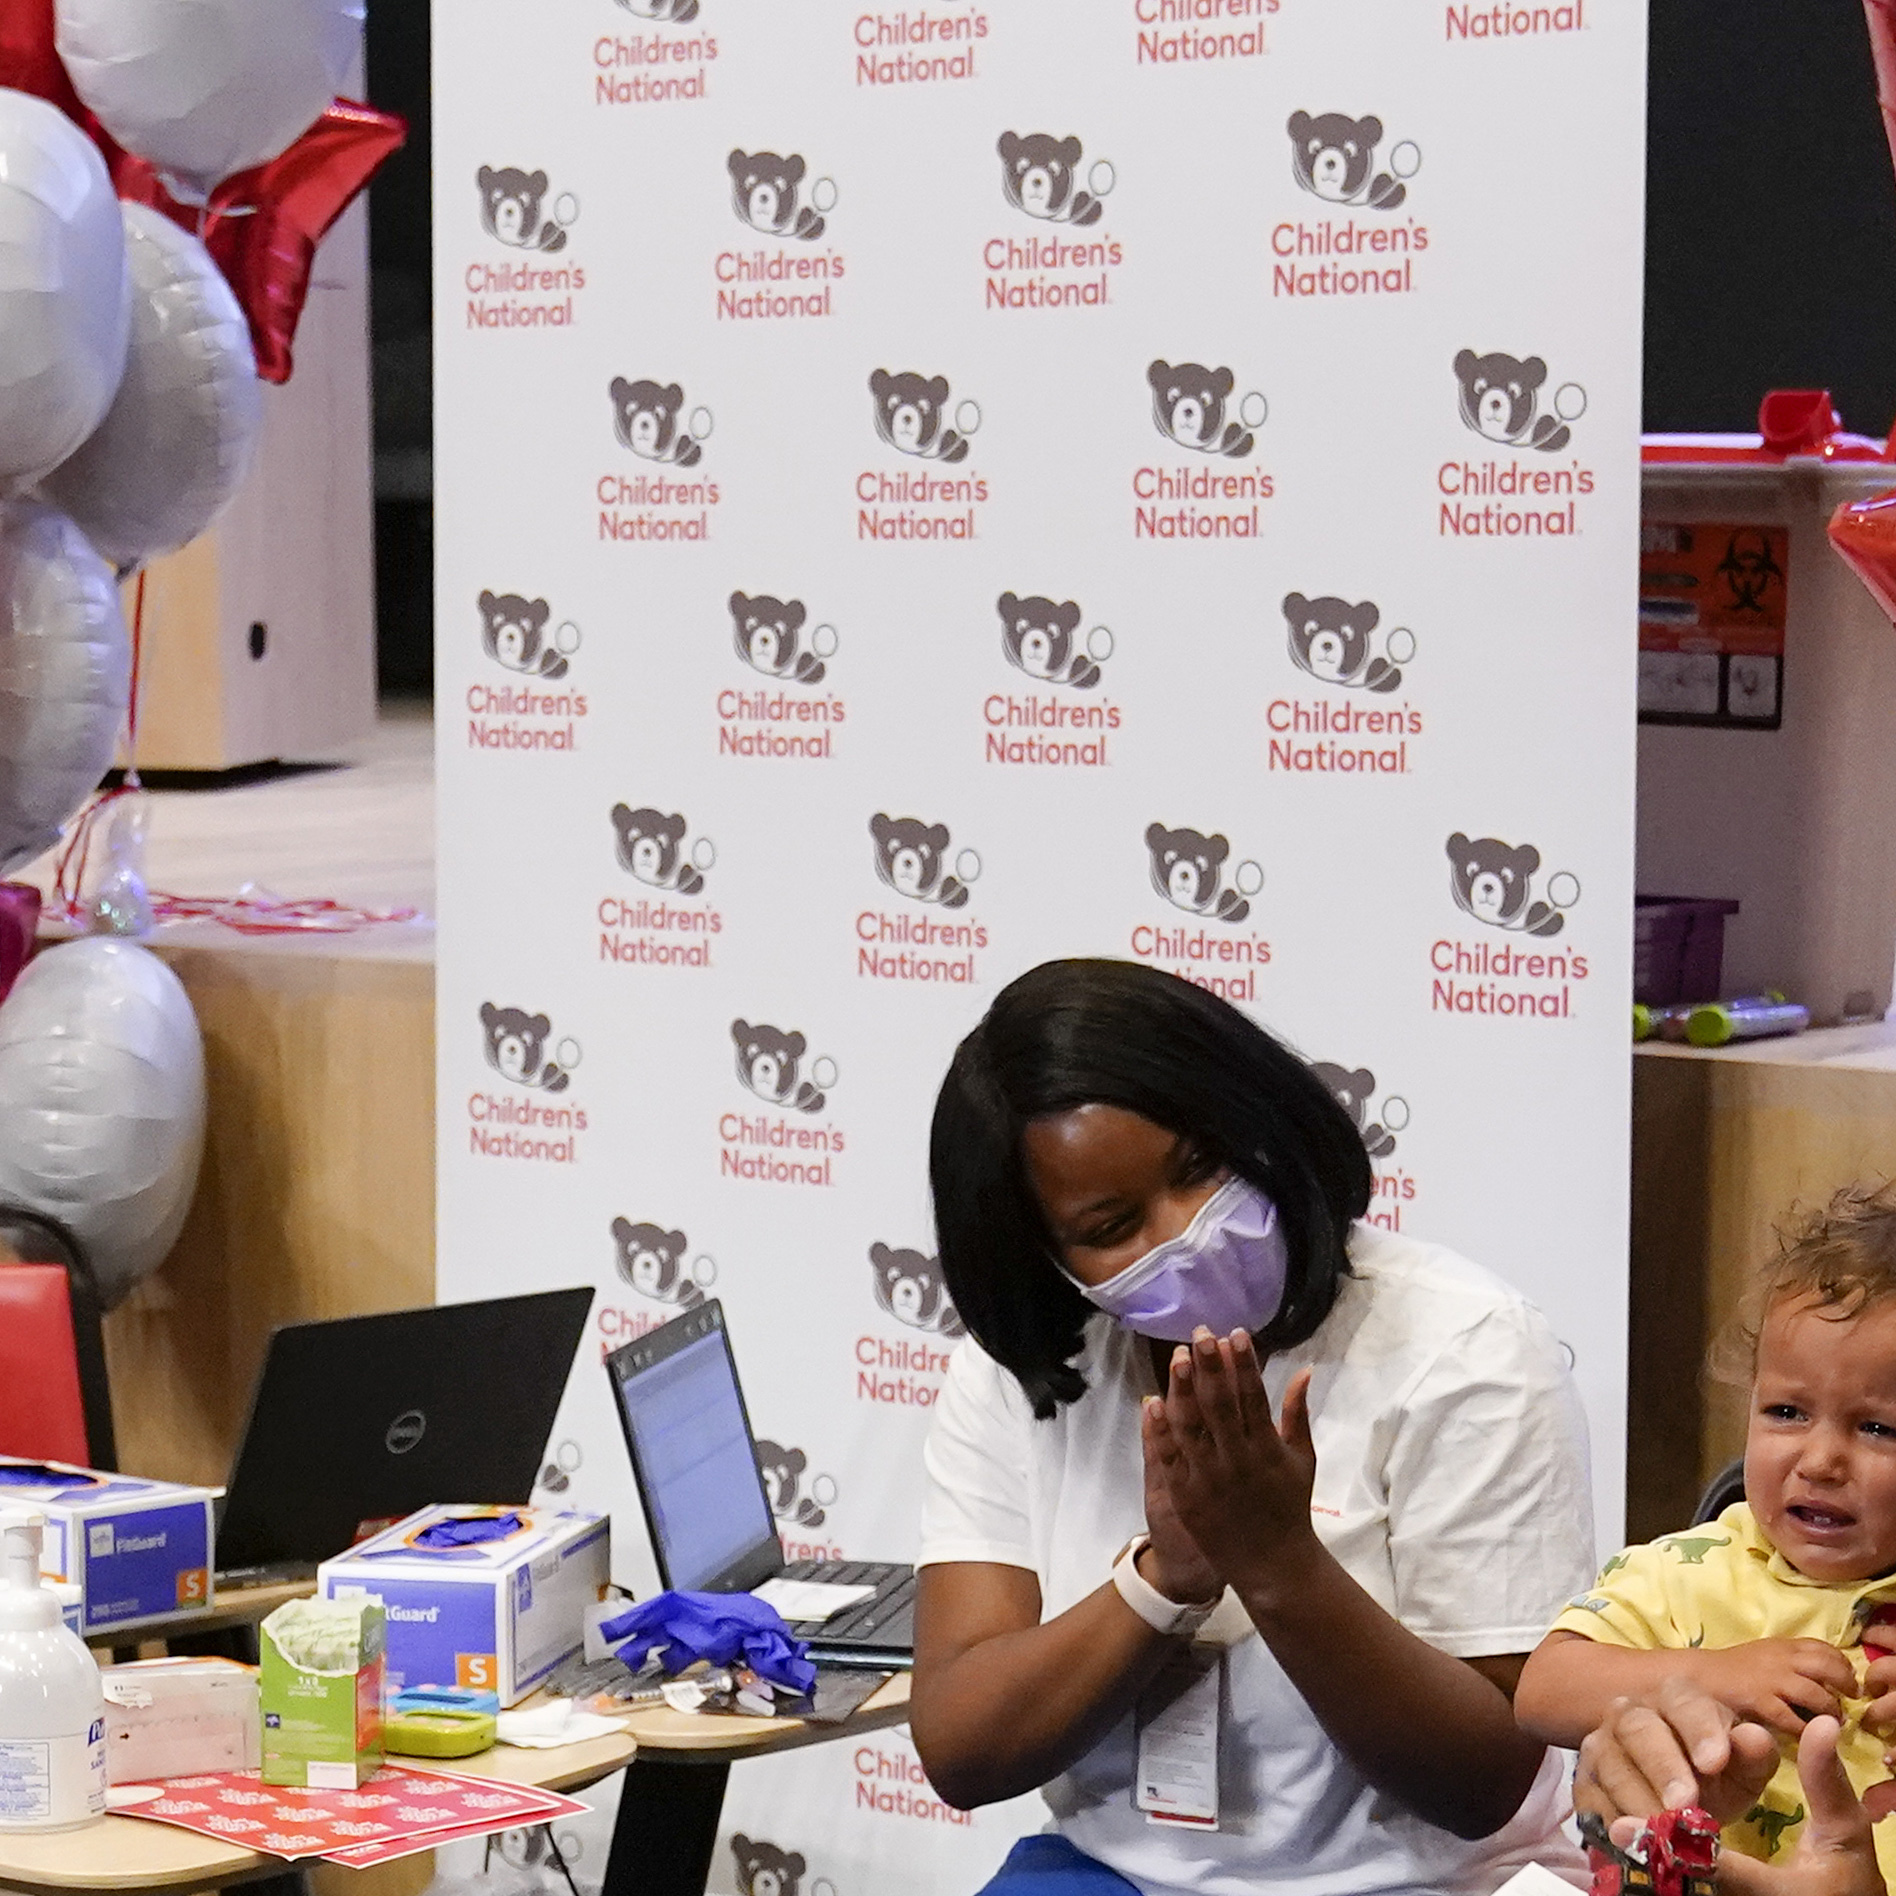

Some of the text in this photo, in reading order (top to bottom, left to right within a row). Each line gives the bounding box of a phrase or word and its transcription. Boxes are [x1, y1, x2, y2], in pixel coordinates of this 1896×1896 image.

[854, 8, 988, 48] Children's
[1445, 0, 1583, 40] National
[594, 34, 718, 69] Children's
[1137, 23, 1264, 64] National
[856, 48, 974, 85] National
[596, 68, 705, 104] National
[983, 235, 1123, 271] Children's
[1271, 217, 1429, 257] Children's
[466, 263, 586, 293] Children's
[714, 250, 845, 283] Children's
[1273, 258, 1413, 296] National
[717, 286, 831, 319] National
[985, 273, 1109, 308] National
[467, 297, 573, 328] National
[597, 475, 720, 506] Children's
[856, 472, 989, 503] Children's
[1132, 467, 1275, 500] Children's
[1437, 461, 1595, 496] Children's
[599, 511, 708, 541] National
[858, 509, 974, 540] National
[1135, 505, 1259, 538] National
[1439, 501, 1575, 536] National
[467, 685, 587, 717] Children's
[717, 689, 845, 722] Children's
[983, 695, 1121, 729] Children's
[1266, 699, 1423, 734] Children's
[468, 720, 574, 751] National
[719, 726, 831, 758] National
[985, 732, 1106, 766] National
[1268, 738, 1408, 773] National
[598, 898, 722, 933] Children's
[855, 911, 988, 948] Children's
[600, 933, 709, 966] National
[1130, 926, 1271, 964] Children's
[1429, 940, 1589, 980] Children's
[857, 947, 974, 982] National
[1432, 979, 1569, 1018] National
[470, 1094, 588, 1130] Children's
[472, 1128, 574, 1162] National
[720, 1115, 845, 1152] Children's
[722, 1151, 832, 1186] National
[855, 1336, 950, 1373] Childre
[857, 1371, 939, 1407] Natio
[186, 1572, 200, 1598] S
[384, 1605, 438, 1623] tGuard
[468, 1657, 488, 1685] S
